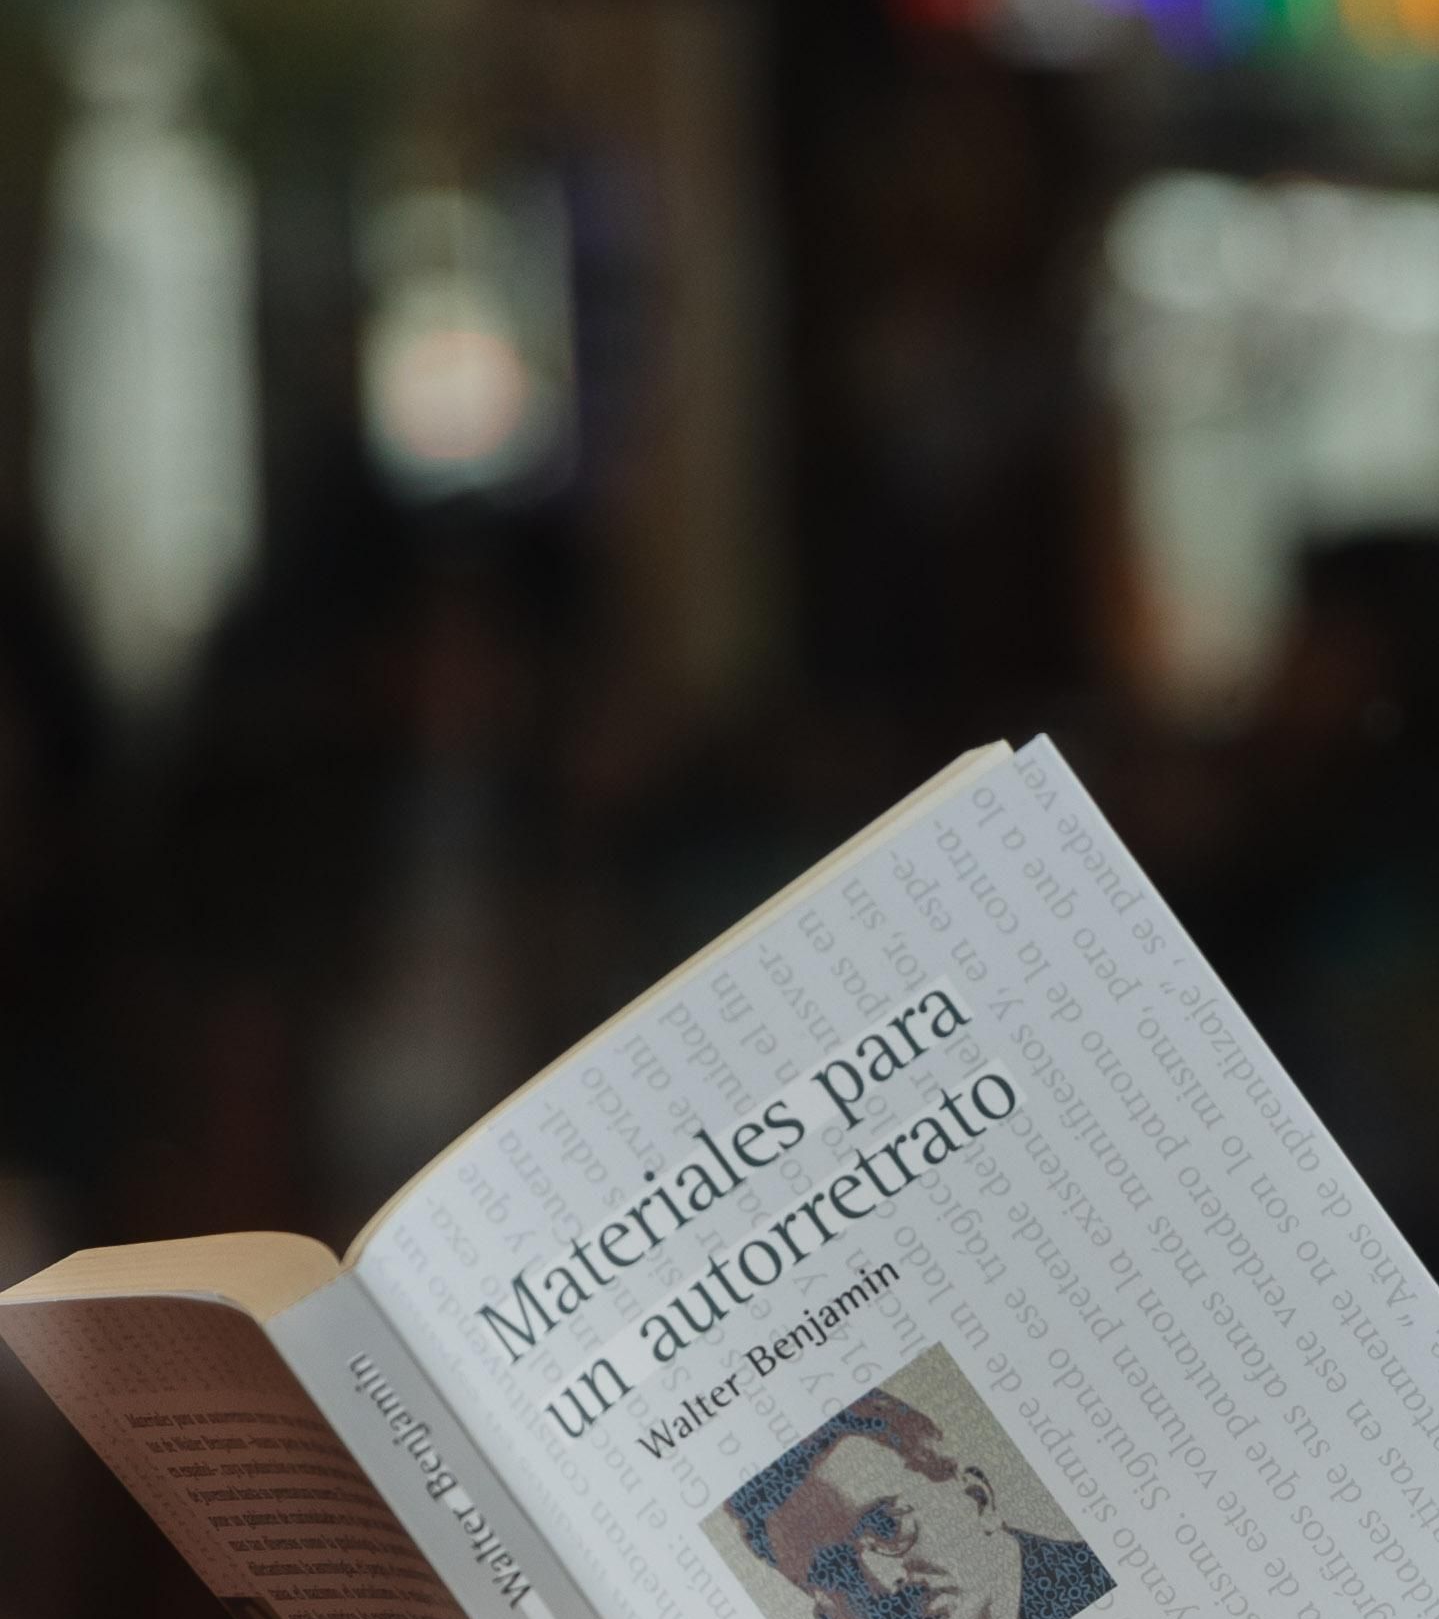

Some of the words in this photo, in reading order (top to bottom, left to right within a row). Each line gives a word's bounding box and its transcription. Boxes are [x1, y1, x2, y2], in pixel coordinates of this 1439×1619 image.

[971, 787, 1006, 827] lo
[1012, 757, 1058, 813] ver
[1000, 825, 1027, 852] a
[1057, 814, 1146, 917] puede
[841, 877, 887, 931] sin
[890, 851, 952, 933] espe-
[933, 820, 1020, 935] contra-
[1022, 857, 1079, 920] que
[797, 908, 835, 954] en
[950, 937, 988, 983] en
[1016, 939, 1052, 983] la
[1131, 918, 1166, 955] se
[710, 970, 755, 1024] fin
[1072, 927, 1143, 1005] pero
[987, 987, 1025, 1022] y,
[1046, 981, 1083, 1023] de
[740, 1022, 778, 1056] el
[1136, 1005, 1226, 1131] mismo,
[1009, 1023, 1154, 1213] manifiestos
[1080, 1030, 1192, 1162] patrono
[478, 1100, 805, 1363] Materiales
[811, 990, 969, 1130] para
[997, 1106, 1113, 1247] existenci
[1221, 1135, 1255, 1175] lo
[1249, 1171, 1300, 1234] son
[1316, 1177, 1353, 1218] de
[392, 1224, 428, 1274] un
[546, 1358, 632, 1438] un
[640, 1074, 1016, 1362] autorretrato
[893, 1225, 955, 1306] lado
[1007, 1201, 1127, 1344] pretende
[1108, 1248, 1144, 1292] la
[1147, 1215, 1208, 1289] más
[1177, 1166, 1297, 1329] verdadero
[1295, 1240, 1338, 1287] no
[949, 1300, 991, 1351] un
[1004, 1287, 1049, 1340] ese
[1201, 1290, 1288, 1399] afanes
[428, 1276, 590, 1497] constituyendo
[637, 1373, 740, 1459] Walter
[745, 1263, 900, 1377] Benjamin
[985, 1352, 1023, 1393] de
[1136, 1287, 1262, 1441] pautaron
[1295, 1330, 1348, 1394] este
[349, 1354, 459, 1502] Benjamin
[1047, 1347, 1172, 1511] Siguiendo
[1111, 1343, 1218, 1490] volumen
[1282, 1404, 1332, 1459] sus
[1345, 1398, 1383, 1442] en
[1018, 1397, 1118, 1523] siempre
[1244, 1440, 1301, 1502] que
[1325, 1462, 1363, 1504] de
[635, 1497, 668, 1529] el
[1216, 1490, 1268, 1553] este
[453, 1506, 533, 1610] Walter
[1263, 1557, 1300, 1598] de
